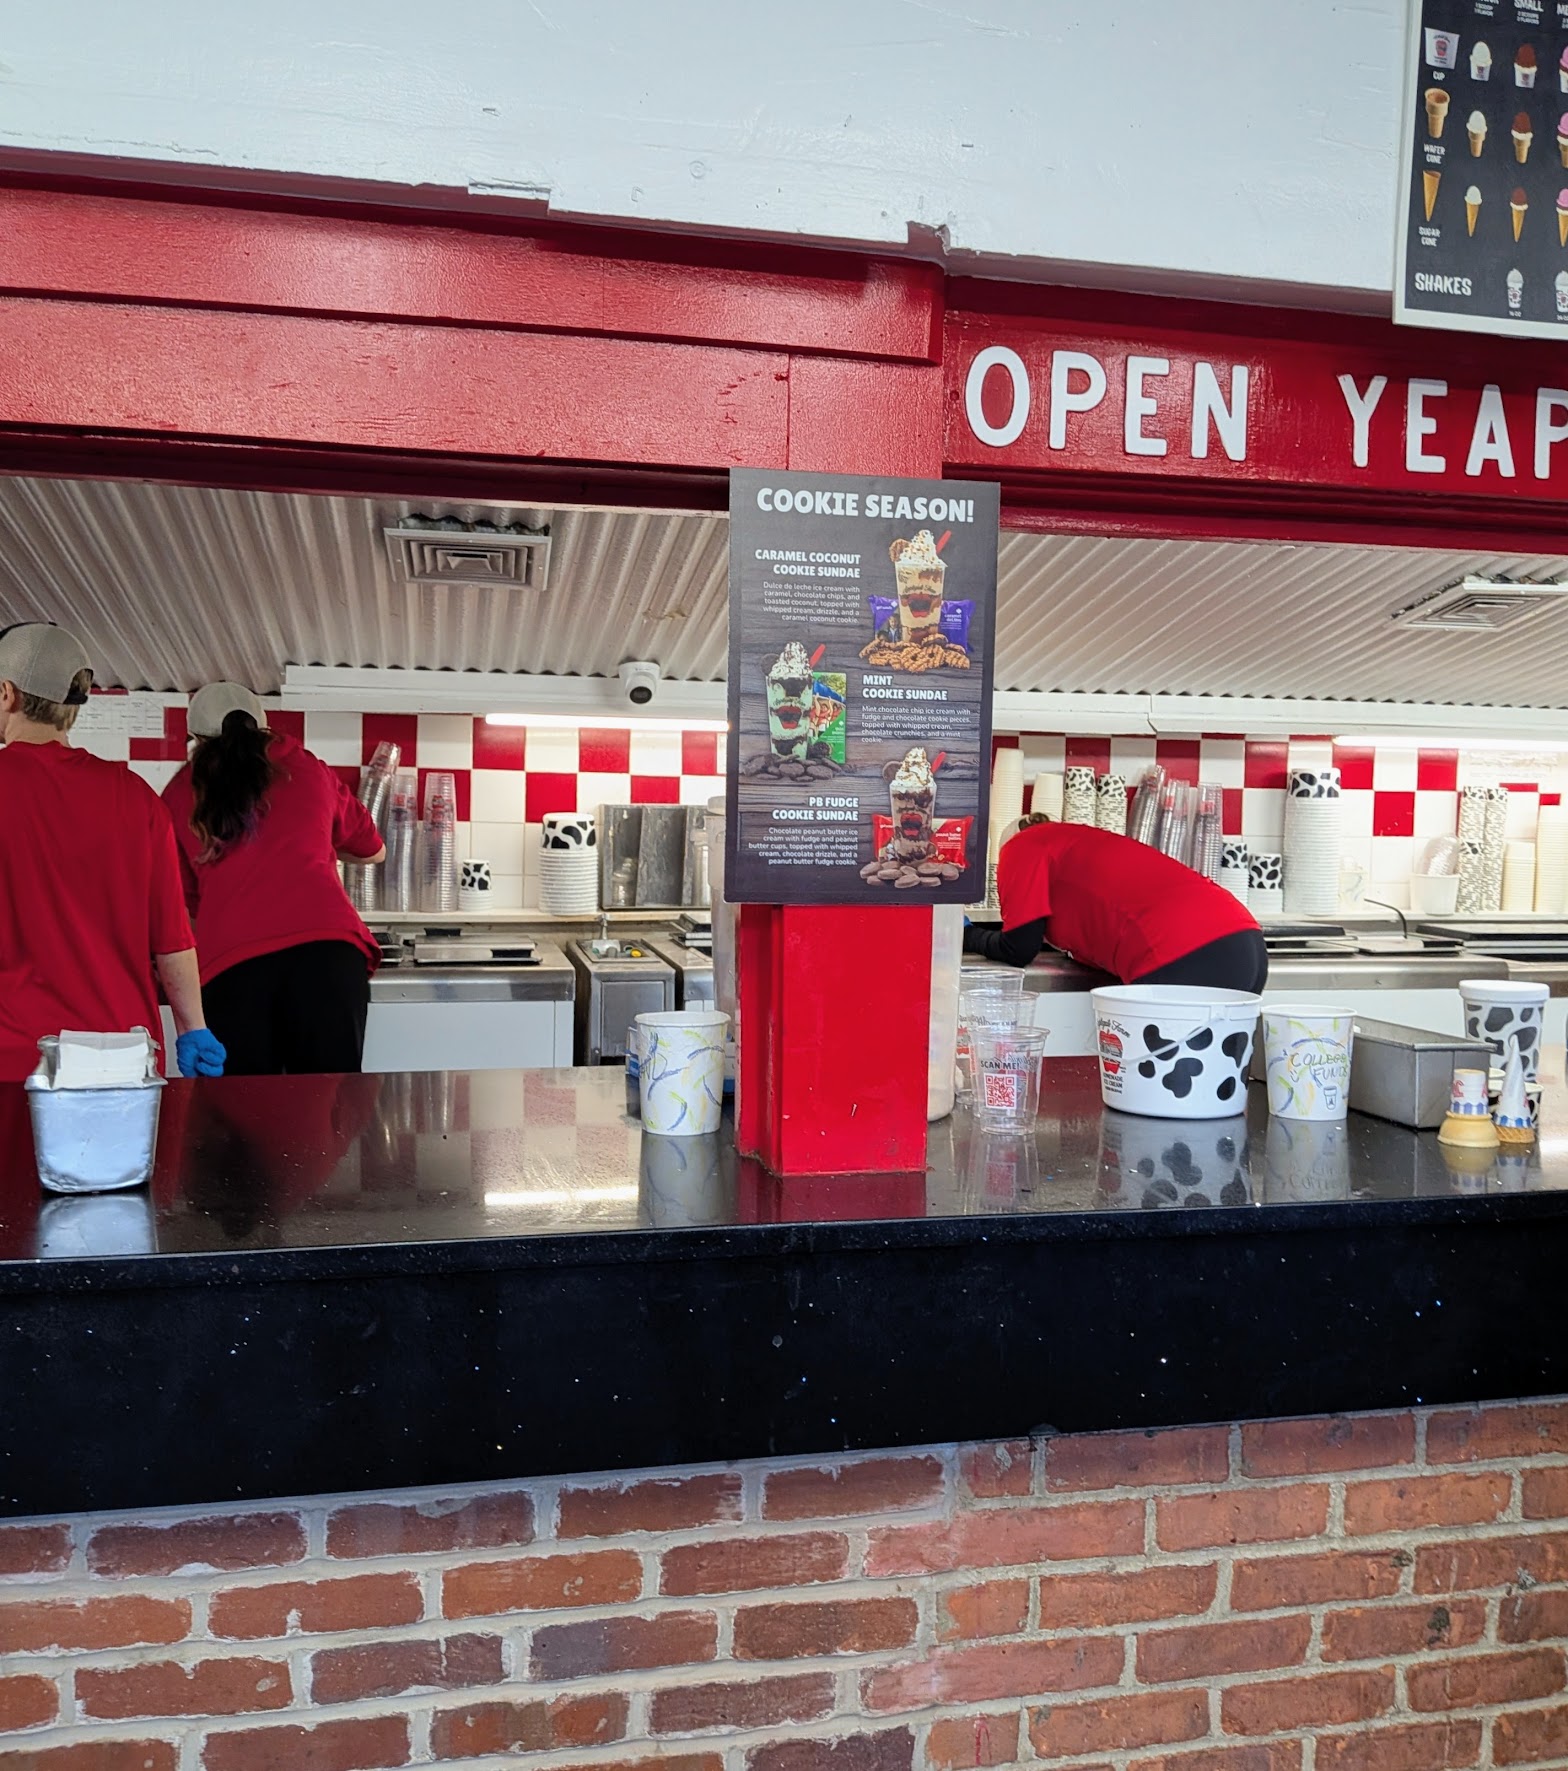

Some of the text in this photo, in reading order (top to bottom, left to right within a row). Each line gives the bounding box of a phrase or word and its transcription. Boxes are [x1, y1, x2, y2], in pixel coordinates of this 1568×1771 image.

[1424, 143, 1445, 155] WAFER
[1419, 226, 1440, 237] SUGAR
[1415, 272, 1472, 296] SHAKES
[965, 346, 1249, 461] OPEN
[757, 487, 974, 522] COOKIE SEASON!
[755, 549, 861, 564] CARAMEL COCONUT
[773, 564, 860, 578] COOKIE SUNDAE
[863, 675, 893, 685] MINT
[863, 688, 947, 700] COOKIE SUNDAE
[910, 707, 925, 715] chip
[809, 797, 858, 807] PB FUDGE
[773, 810, 858, 820] COOKIE SUNDAE
[980, 1060, 1000, 1069] SCAN
